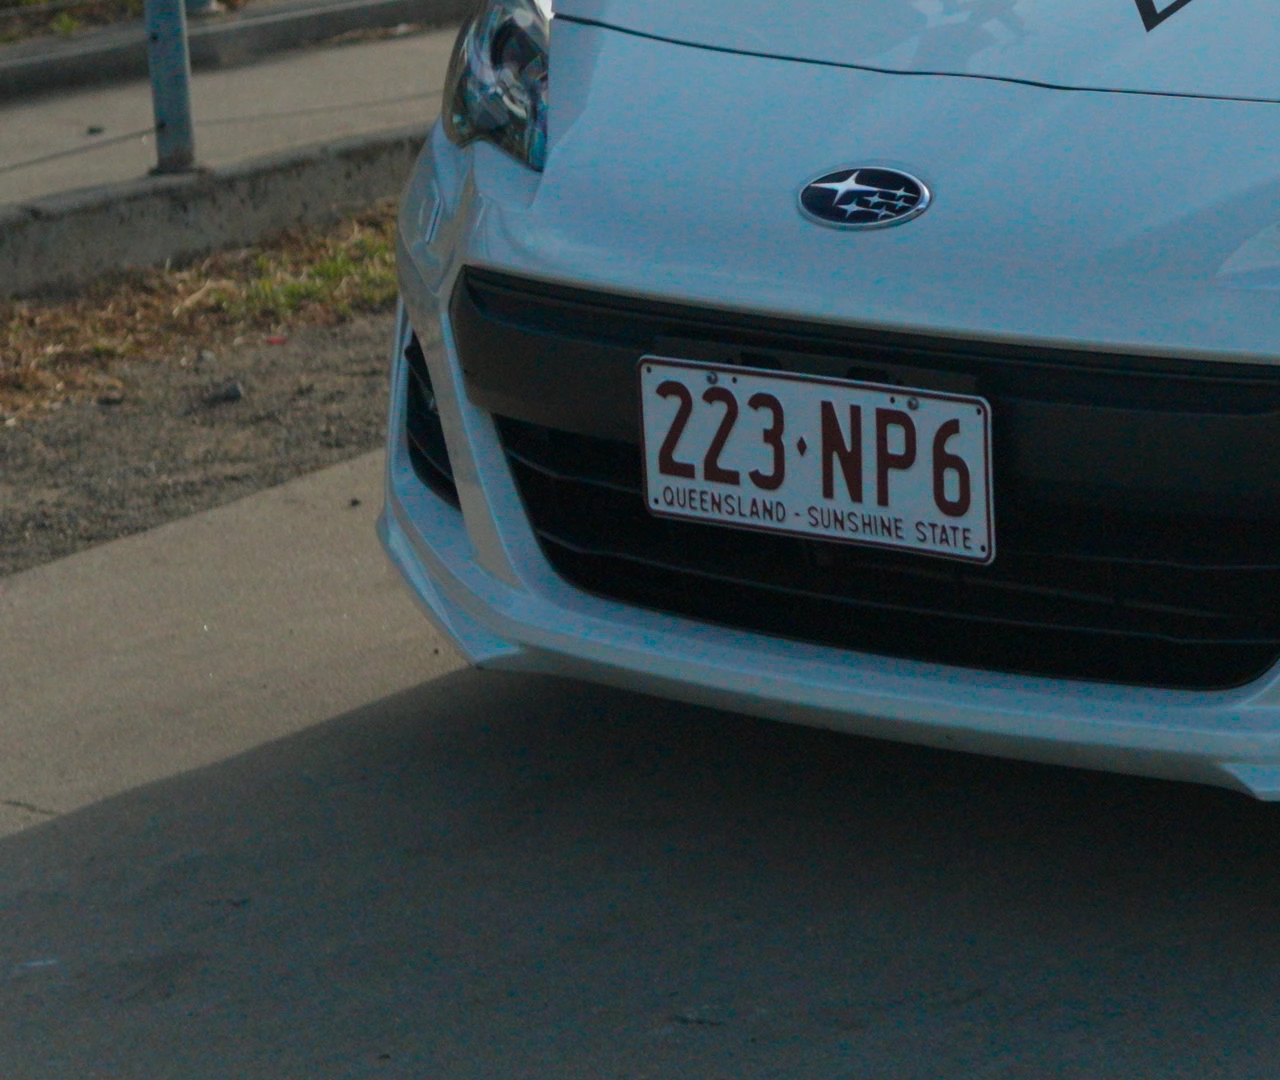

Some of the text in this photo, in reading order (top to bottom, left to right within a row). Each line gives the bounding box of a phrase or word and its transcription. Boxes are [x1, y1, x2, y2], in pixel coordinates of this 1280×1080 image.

[663, 486, 786, 522] QUEENSLAND
[808, 506, 905, 540] SUNSHINE
[915, 522, 973, 550] STATE
